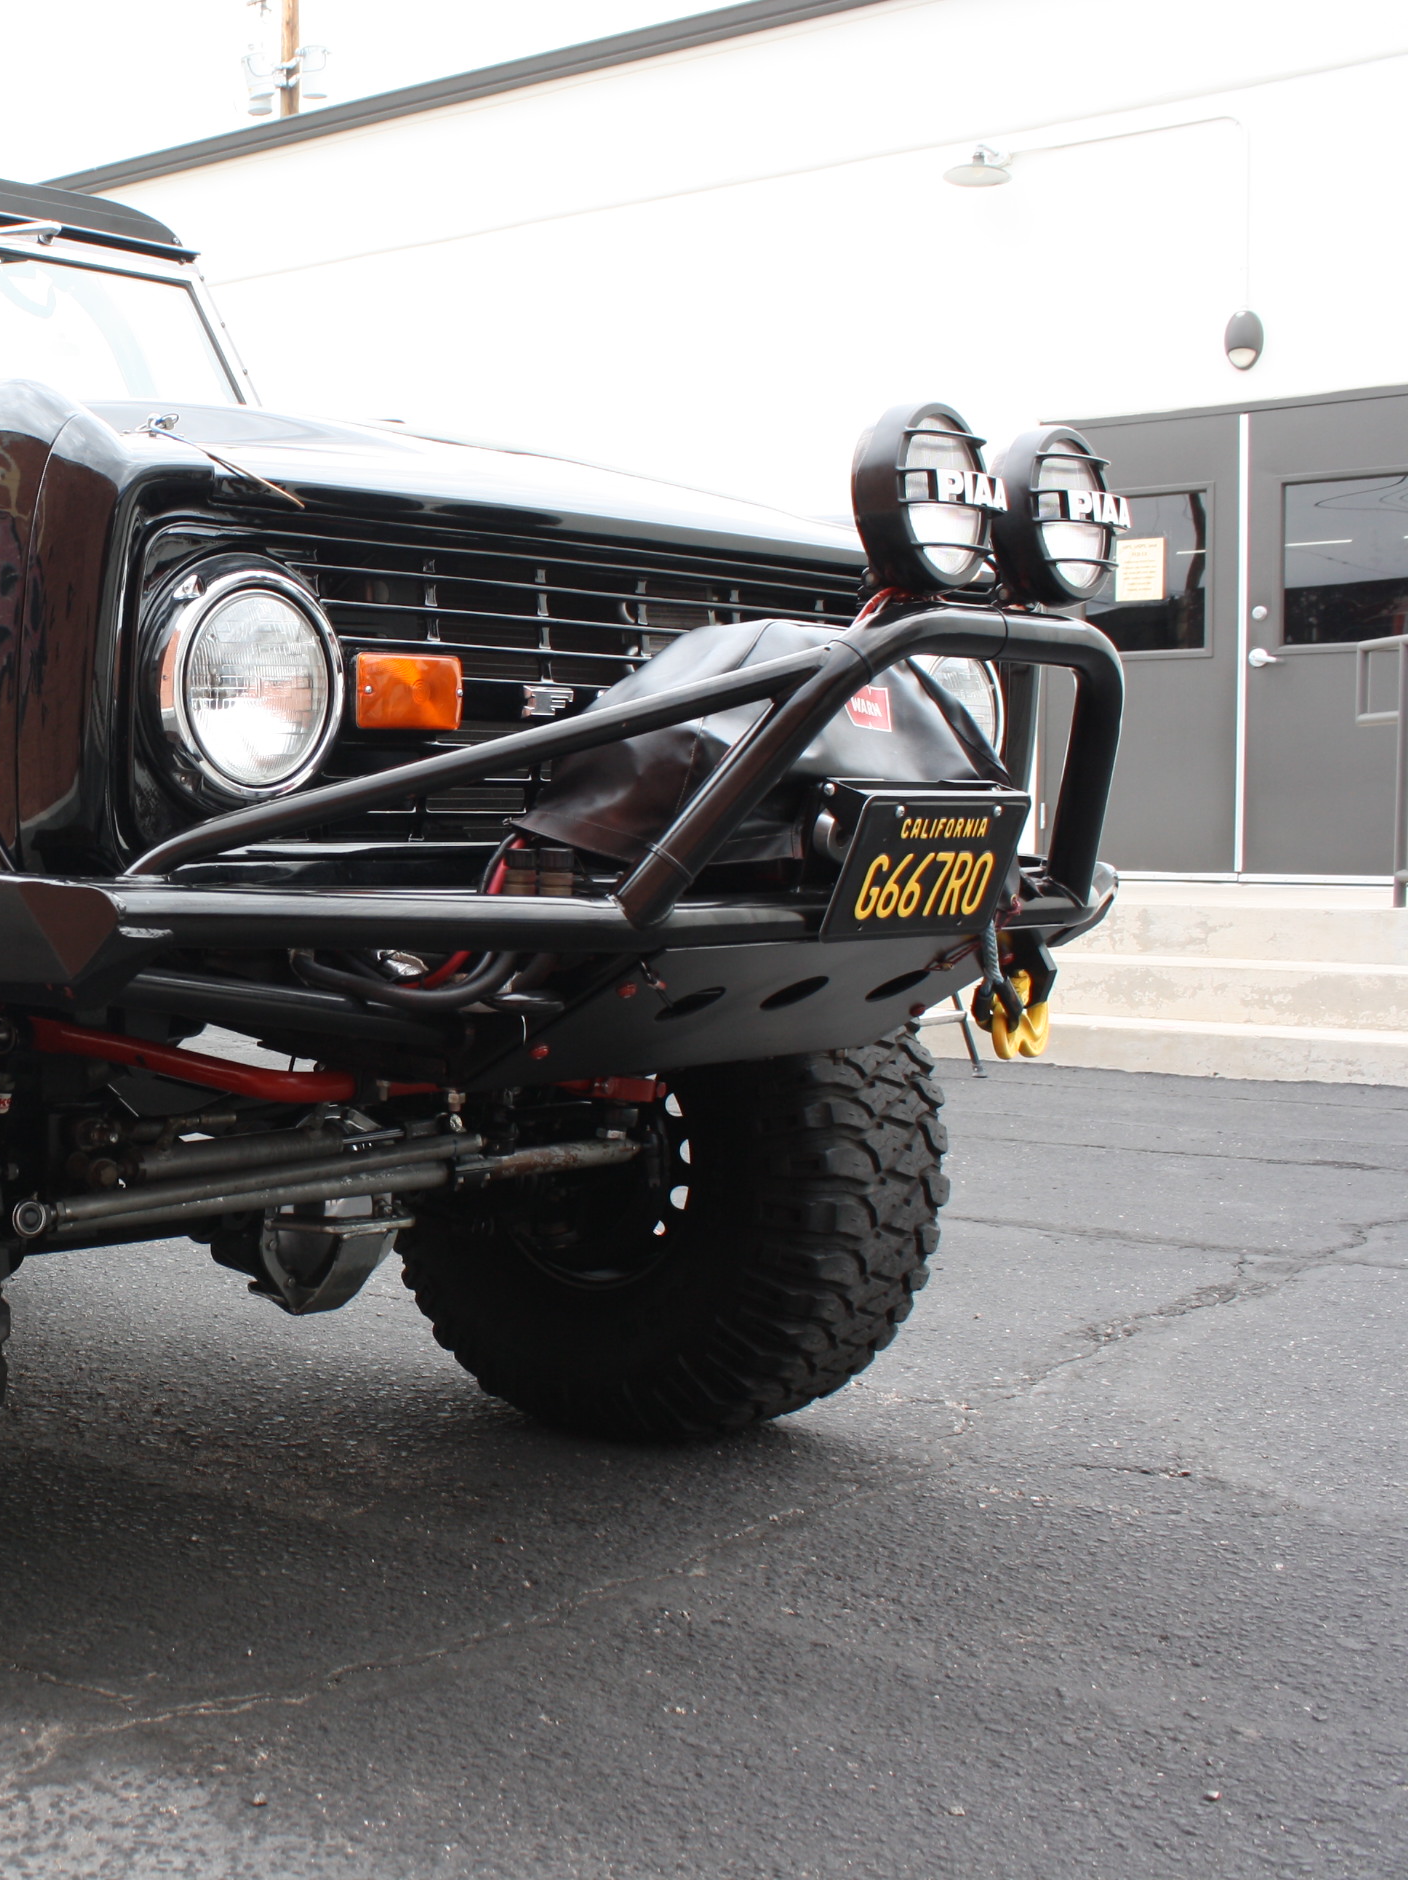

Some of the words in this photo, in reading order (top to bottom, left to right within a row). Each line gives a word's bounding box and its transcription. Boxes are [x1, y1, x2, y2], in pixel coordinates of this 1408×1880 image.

[935, 468, 1008, 512] PIAA
[1067, 490, 1132, 528] PIAA
[850, 696, 883, 718] WARN
[900, 816, 990, 840] CALIFORNIA
